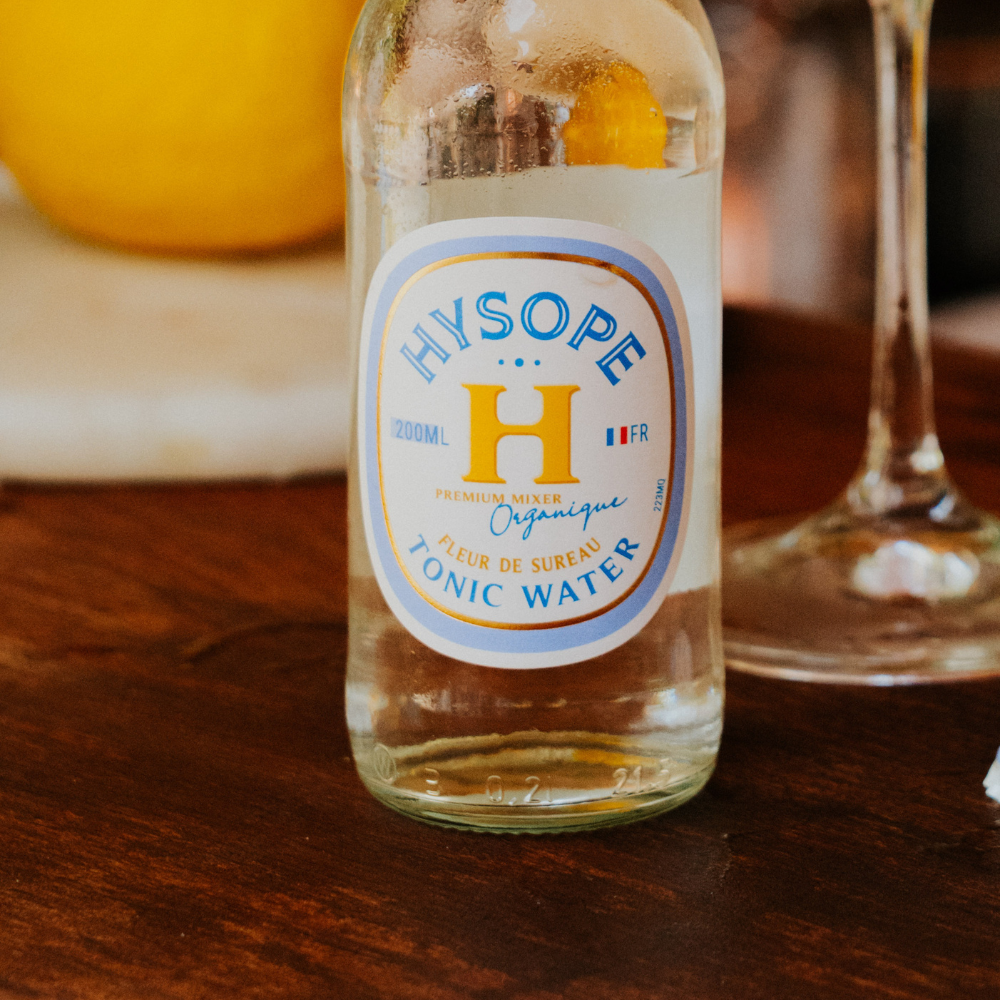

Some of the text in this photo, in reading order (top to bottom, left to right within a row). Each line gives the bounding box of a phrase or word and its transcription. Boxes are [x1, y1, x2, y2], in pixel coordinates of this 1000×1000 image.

[400, 291, 647, 386] HYSOPE
[396, 419, 450, 446] 200ML
[460, 383, 582, 485] H
[631, 423, 648, 443] FR
[436, 488, 562, 505] PREMIUM MIXER
[490, 497, 628, 540] Organique
[409, 533, 640, 608] TONIC WATER
[437, 534, 601, 573] FLEUR DE SUREAU
